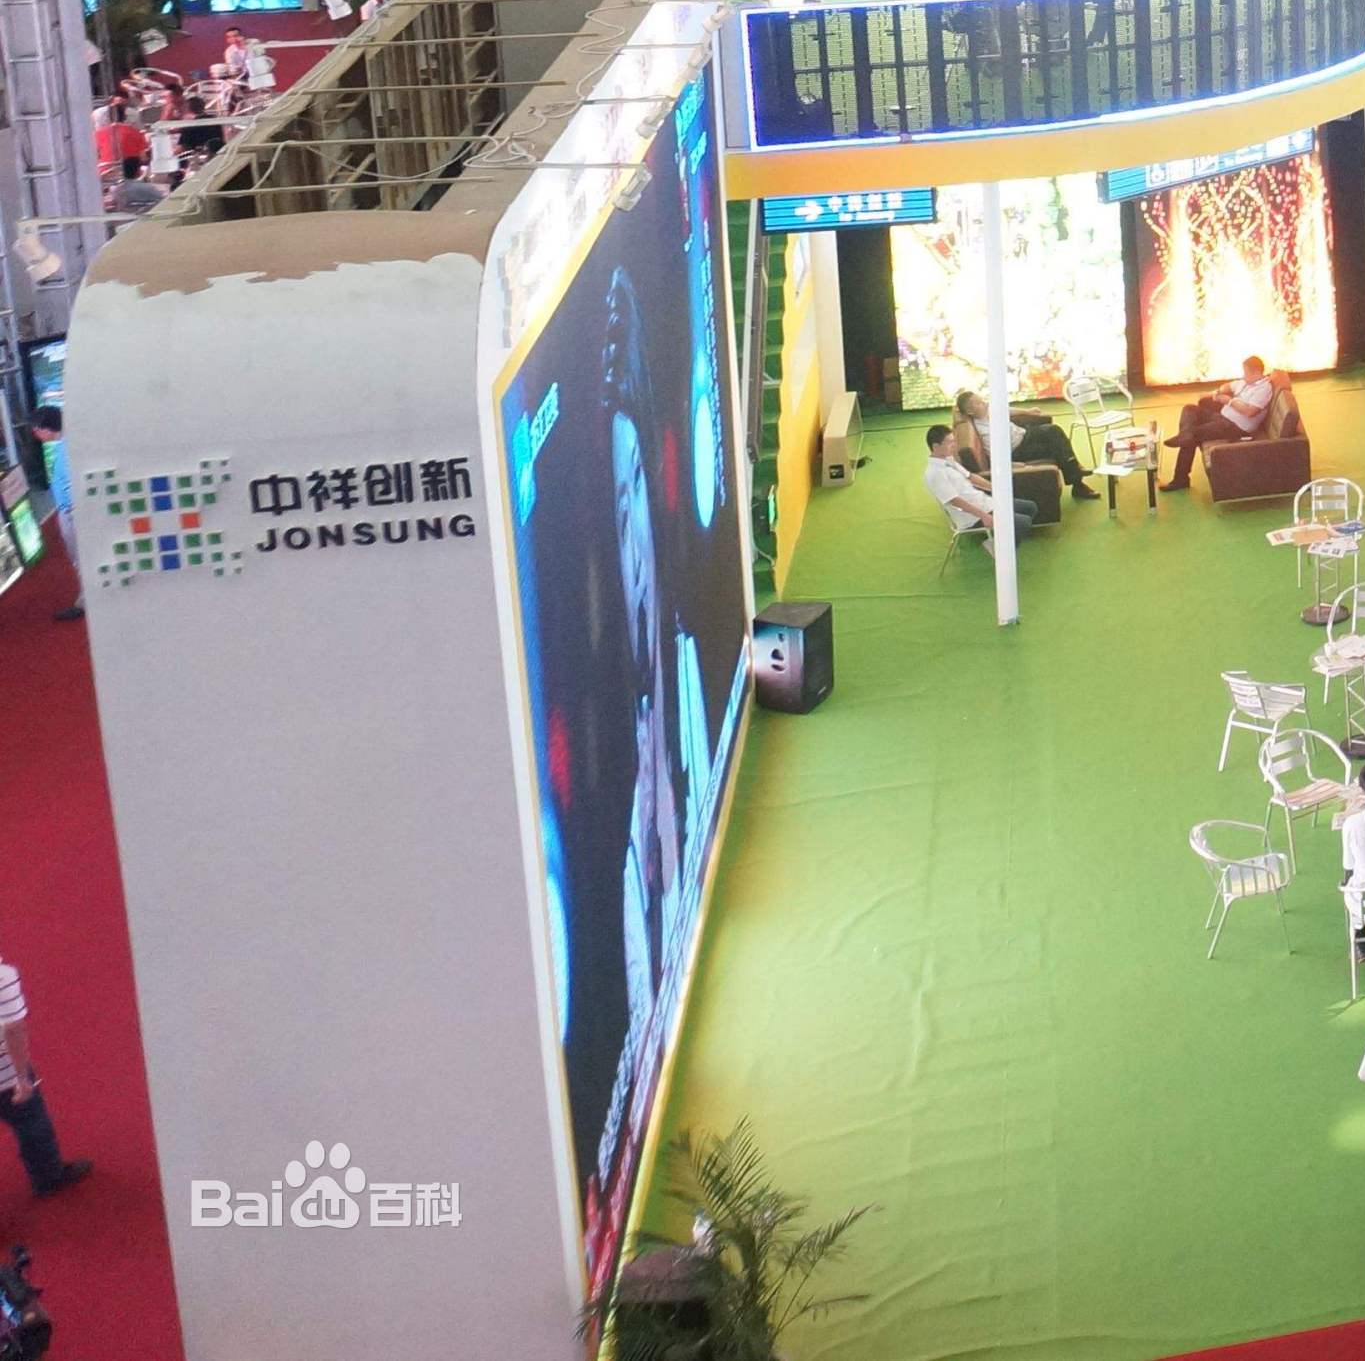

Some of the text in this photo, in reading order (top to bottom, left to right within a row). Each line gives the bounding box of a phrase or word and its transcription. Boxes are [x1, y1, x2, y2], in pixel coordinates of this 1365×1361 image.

[249, 456, 474, 517] 中祥创新
[255, 513, 478, 553] JONSUNG
